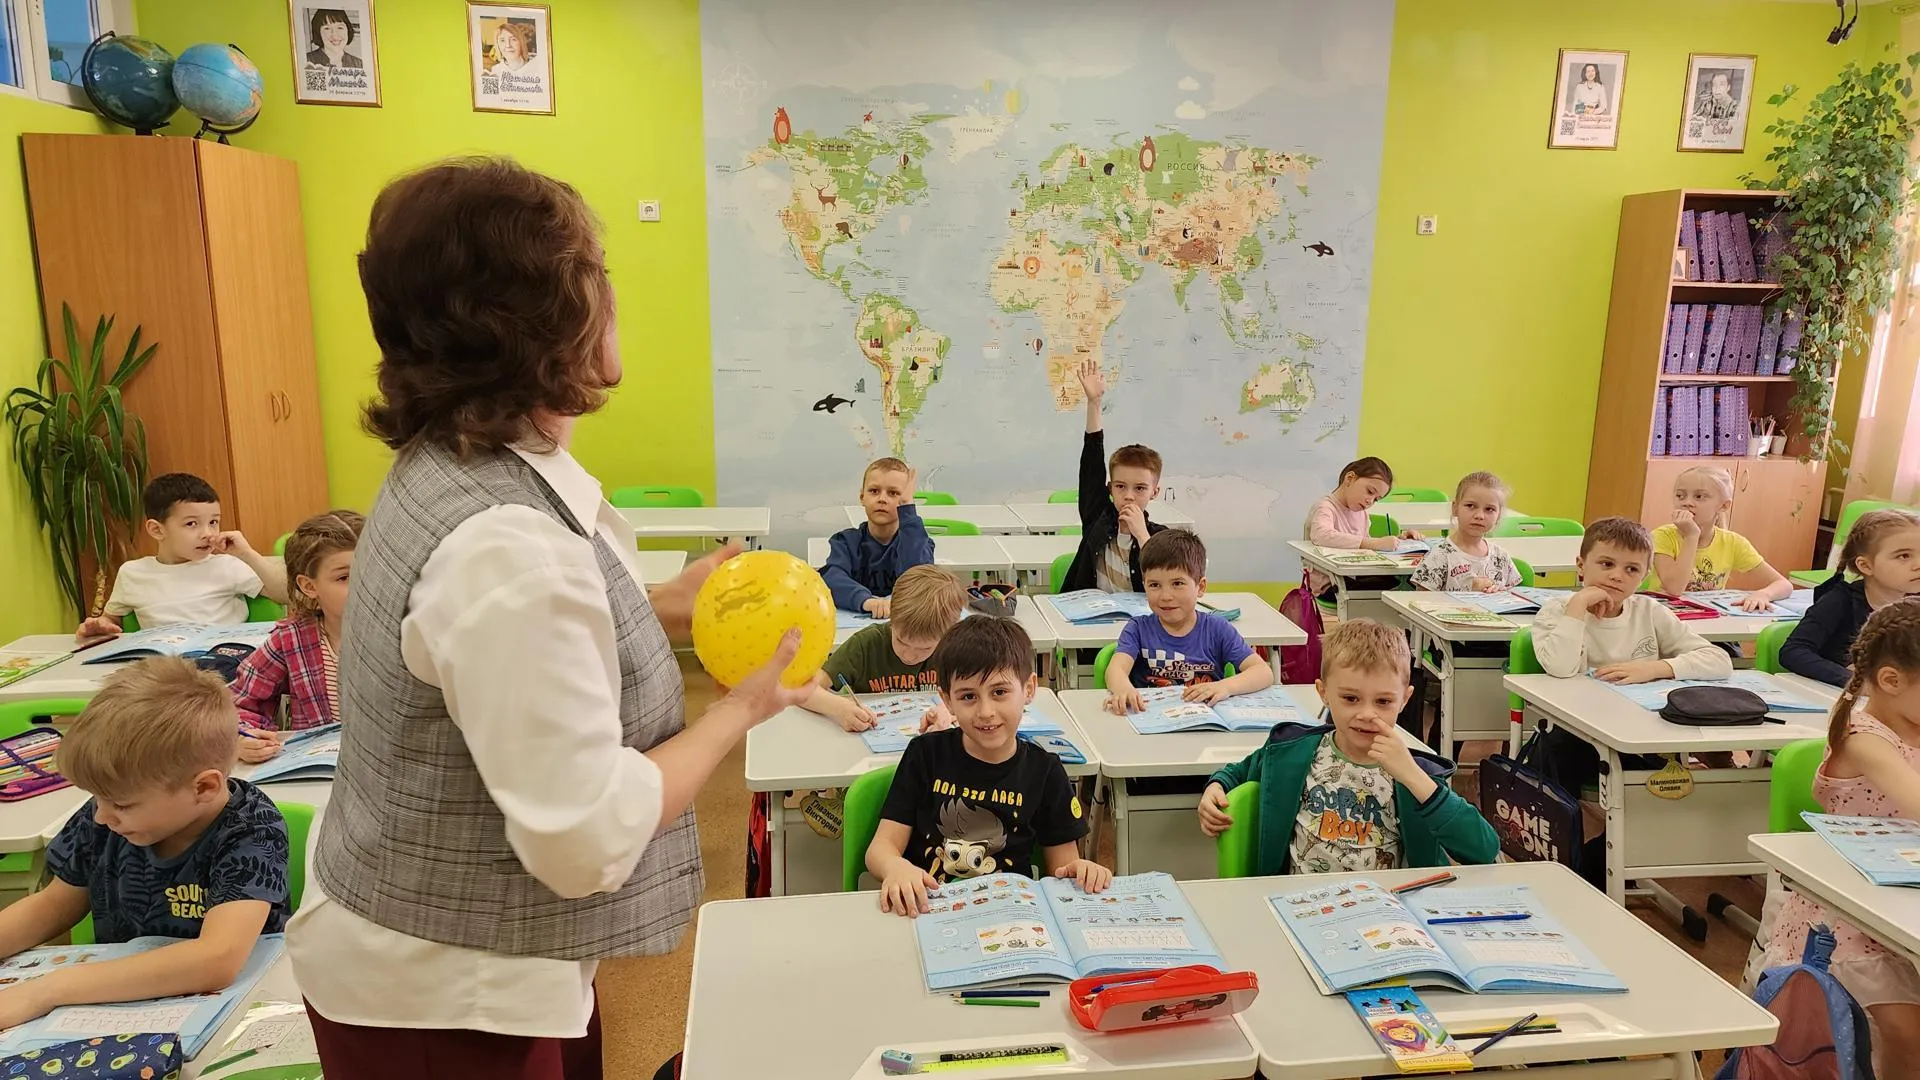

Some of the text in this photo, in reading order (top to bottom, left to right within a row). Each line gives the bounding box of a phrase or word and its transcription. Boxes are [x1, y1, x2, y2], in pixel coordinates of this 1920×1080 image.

[1167, 162, 1205, 171] РОССИЯ
[868, 674, 917, 692] MILITAR
[933, 779, 957, 796] ПОЛ
[991, 788, 1023, 807] ЛАВА
[805, 805, 839, 834] Виктория
[811, 799, 842, 827] Глазкова
[1496, 798, 1552, 841] GAME
[171, 902, 206, 919] BEAC
